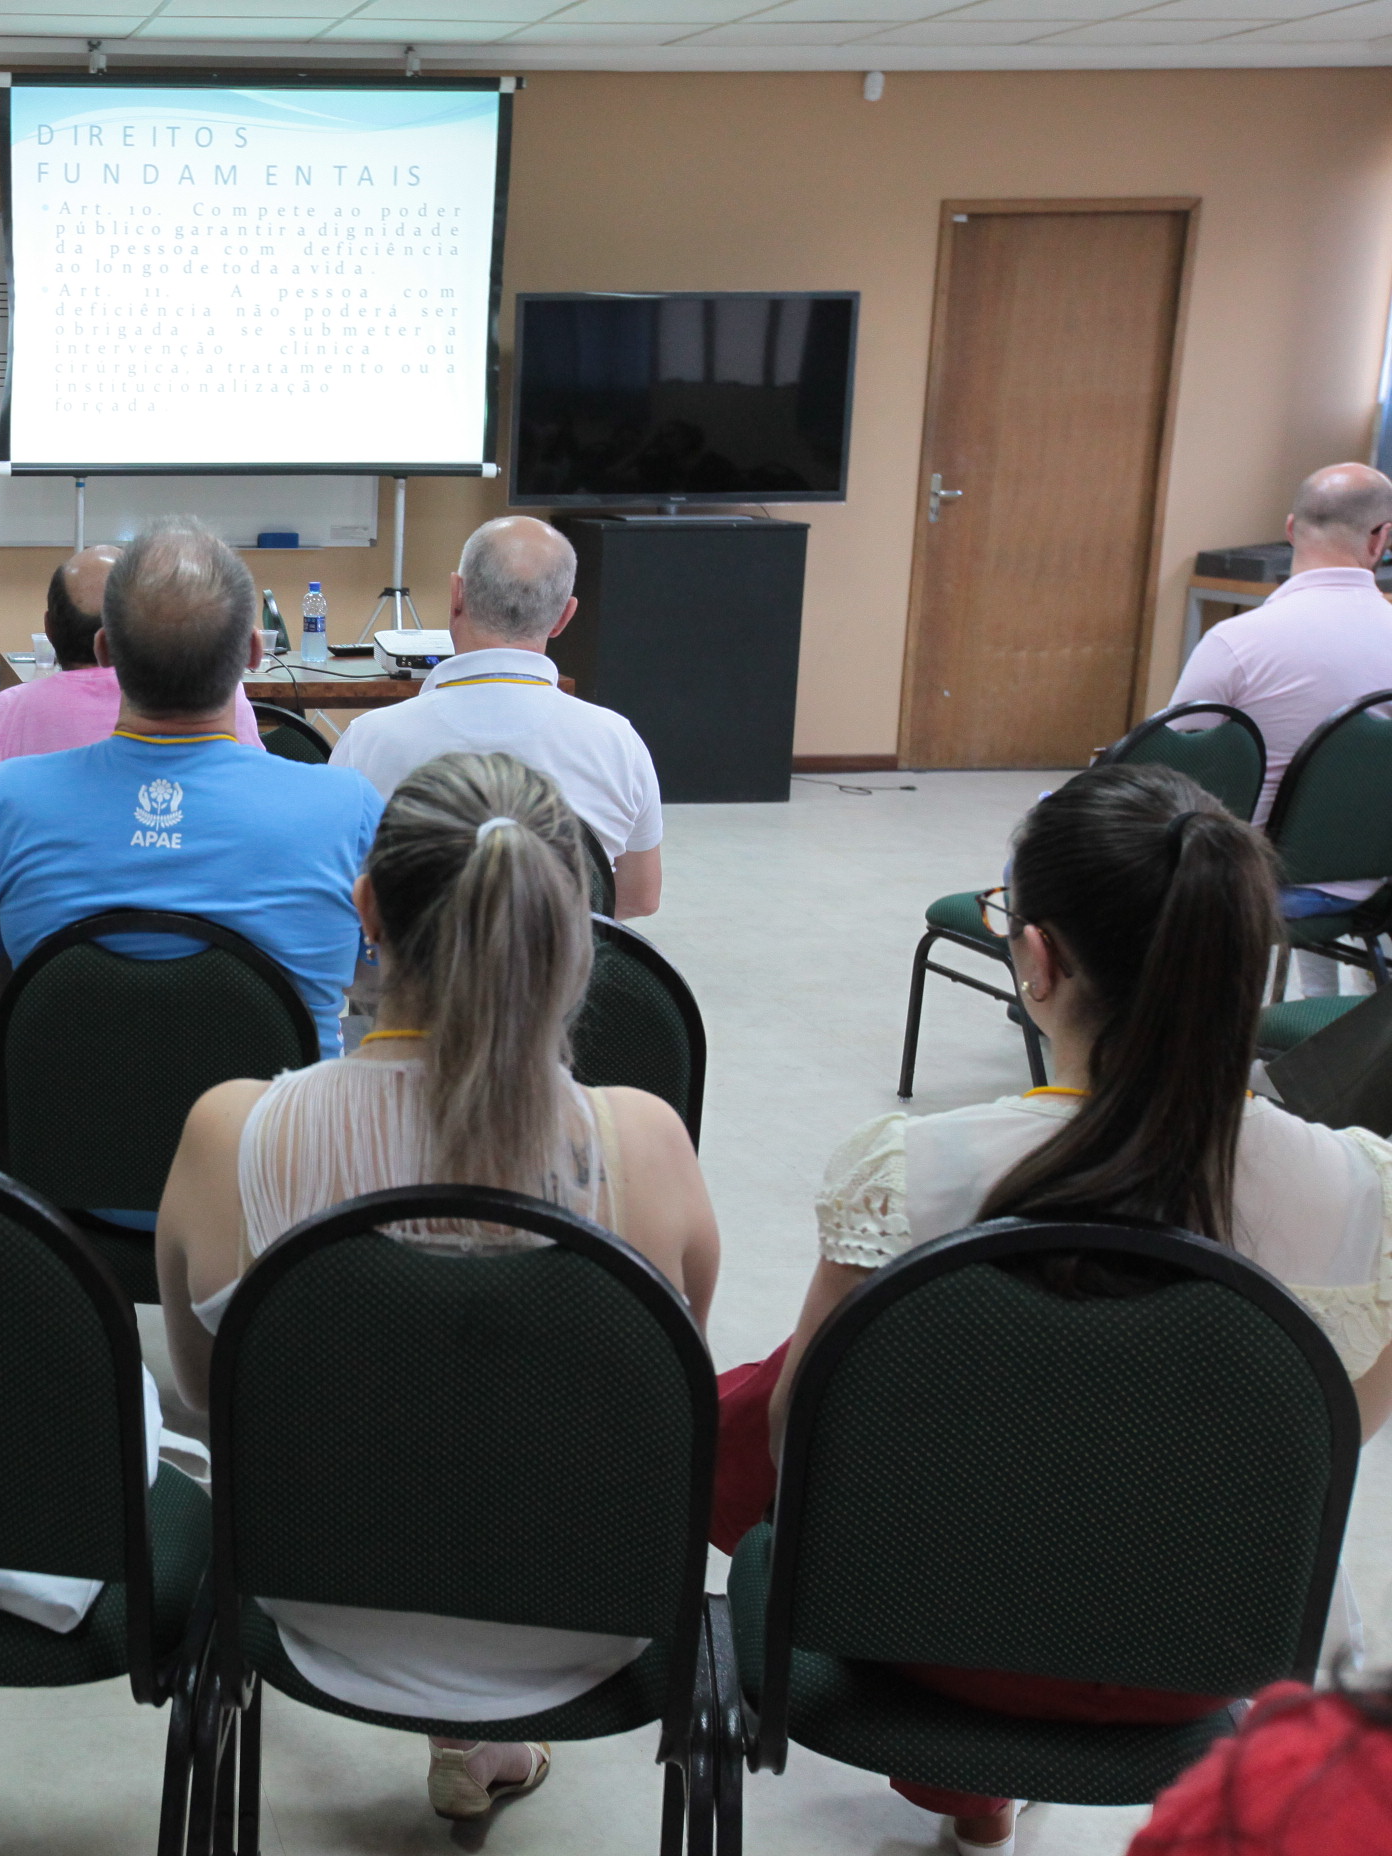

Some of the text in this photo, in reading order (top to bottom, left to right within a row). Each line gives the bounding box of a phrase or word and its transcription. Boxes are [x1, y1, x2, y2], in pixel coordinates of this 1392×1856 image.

[37, 124, 249, 149] DIREITOS
[36, 162, 422, 187] FUNDAMENTAIS
[58, 200, 112, 216] Art.
[192, 201, 316, 221] Compete
[333, 207, 361, 218] ao
[380, 202, 461, 221] poder
[56, 219, 459, 242] público garantir a dignidade
[55, 240, 458, 259] da pessoa com deficiência
[55, 258, 376, 278] ao longo de toda a vida.
[59, 283, 111, 297] Art.
[230, 283, 243, 298] A
[276, 287, 369, 303] pessoa
[402, 287, 454, 299] com
[55, 301, 457, 322] deficiência não poderá ser
[54, 321, 456, 340] obrigada a se submeter a
[55, 340, 224, 358] intervenção
[426, 344, 454, 355] ou
[203, 363, 215, 375] a
[226, 362, 385, 375] tratamento
[400, 364, 429, 374] ou
[445, 364, 455, 375] a
[55, 379, 332, 397] institucionalização
[130, 830, 182, 849] APAE
